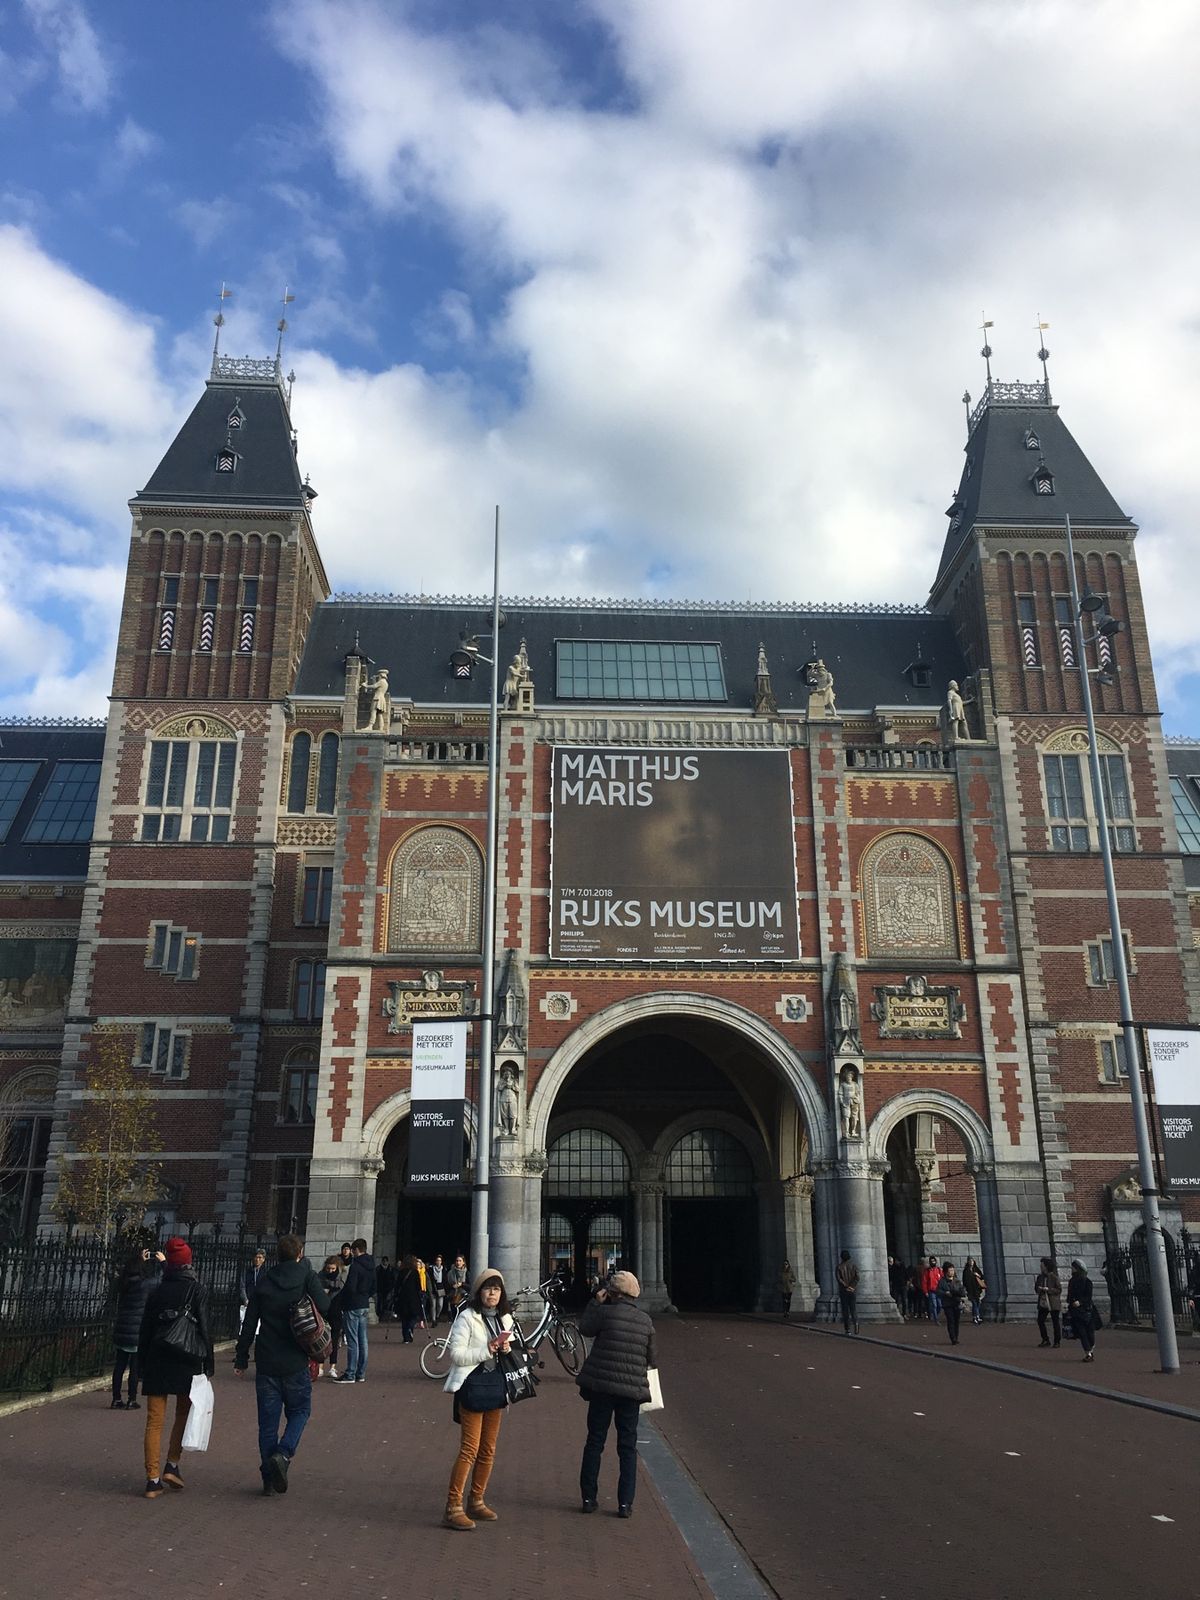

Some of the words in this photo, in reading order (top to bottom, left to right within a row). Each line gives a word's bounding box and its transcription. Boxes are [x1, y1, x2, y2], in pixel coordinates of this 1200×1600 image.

[560, 781, 654, 806] MARIS
[561, 888, 576, 897] T/M
[577, 888, 613, 897] 7.01.2018
[650, 901, 782, 927] MUSEUM
